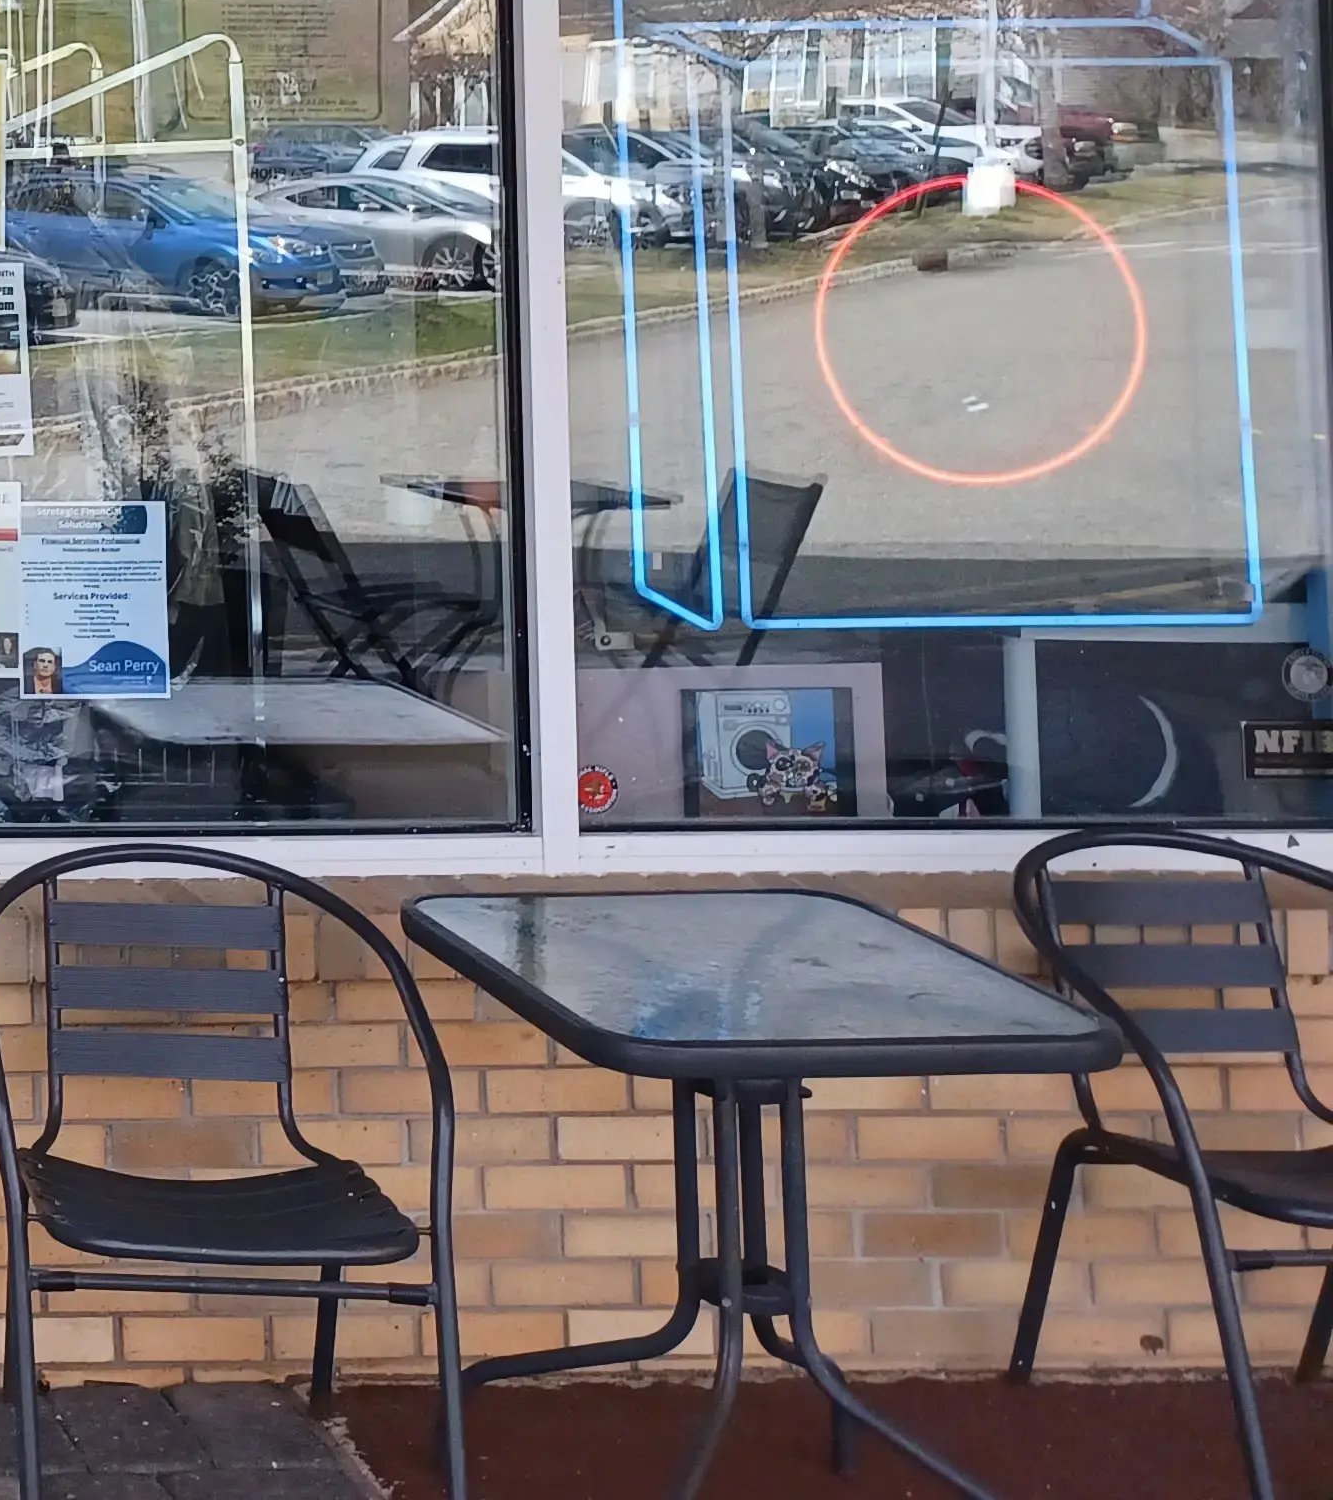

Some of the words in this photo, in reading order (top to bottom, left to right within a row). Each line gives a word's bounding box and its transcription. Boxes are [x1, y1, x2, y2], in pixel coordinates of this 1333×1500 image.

[36, 507, 79, 518] Strategic
[57, 520, 102, 530] Solutions
[53, 592, 89, 600] Services
[90, 592, 131, 601] Provided:
[88, 659, 121, 672] Sean
[124, 659, 160, 675] Perry
